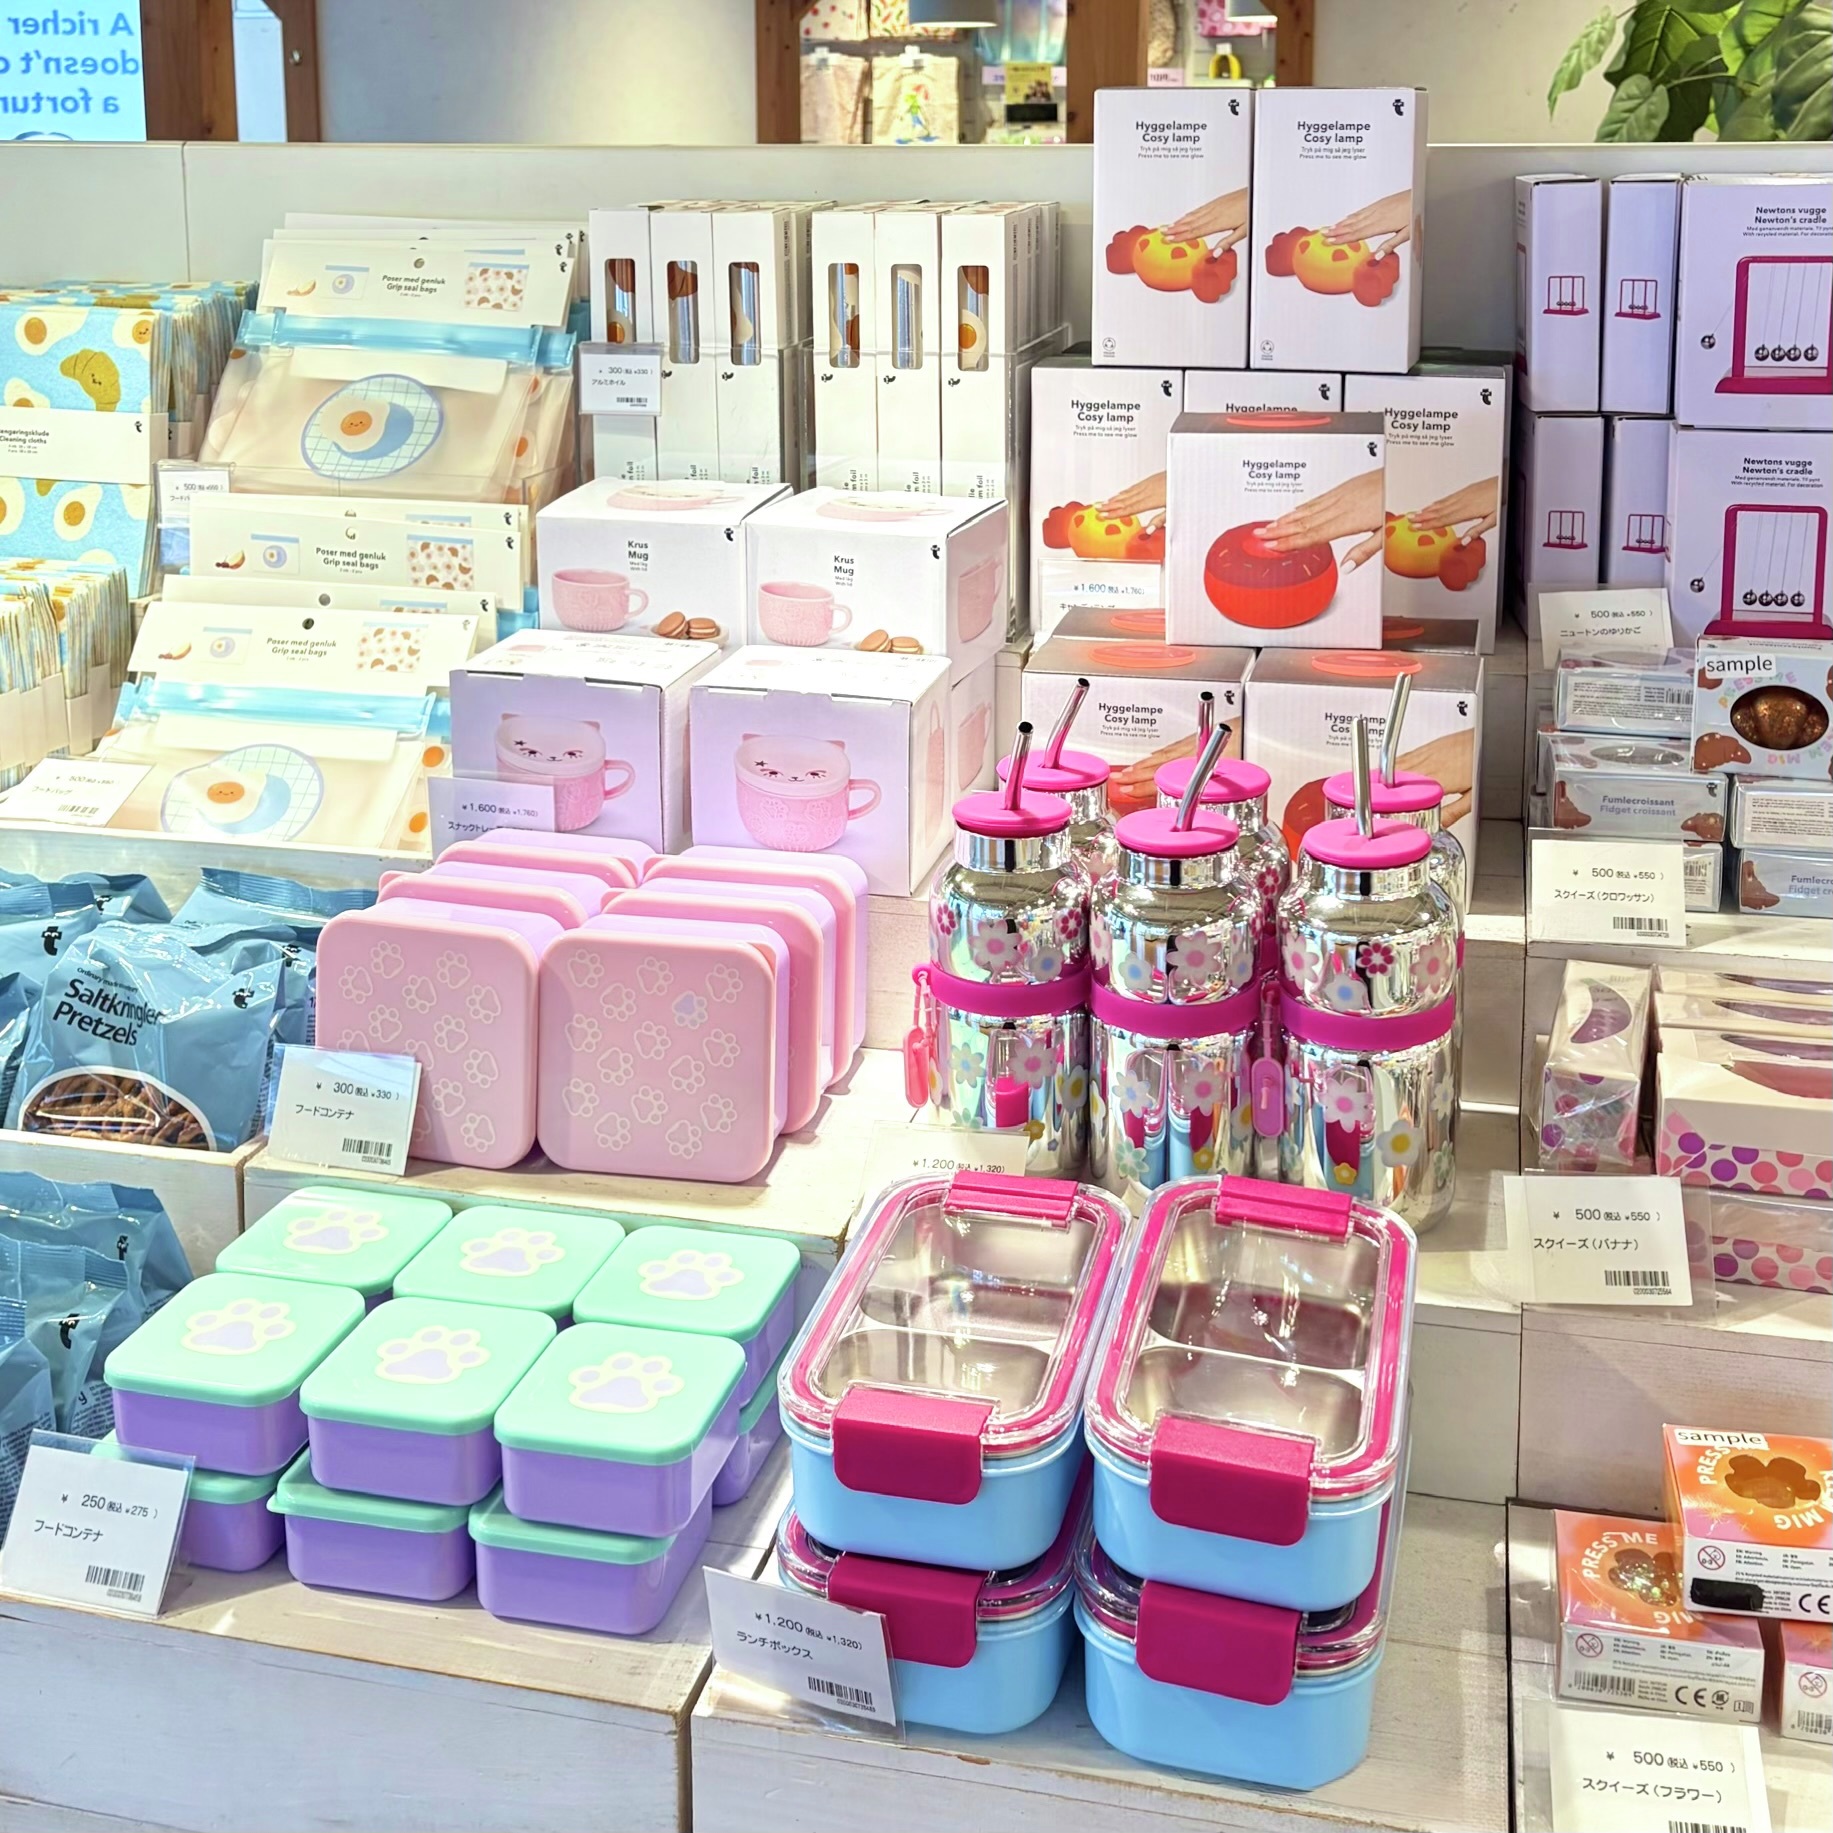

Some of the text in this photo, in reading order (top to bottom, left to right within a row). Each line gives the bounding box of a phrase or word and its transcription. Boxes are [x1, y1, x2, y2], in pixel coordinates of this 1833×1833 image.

[1135, 120, 1208, 133] Hyggelampe
[1297, 121, 1371, 134] Hyggelampe
[1142, 133, 1201, 145] Cosy lamp
[1304, 132, 1364, 146] Cosy lamp
[1798, 207, 1827, 215] vugge
[1755, 215, 1827, 224] Newton's cradle
[608, 366, 623, 374] 300
[592, 378, 626, 386] アルミホイル
[1071, 400, 1141, 413] Hyggelampe
[1077, 411, 1134, 425] Cosy lamp
[1384, 407, 1459, 421] Hyggelampe
[1391, 420, 1451, 433] Cosy lamp
[1242, 460, 1307, 470] Hyggelampe
[1743, 457, 1813, 468] Newtons vugge
[1248, 470, 1301, 481] Cosy lamp
[1742, 466, 1784, 474] Newton's
[628, 540, 648, 549] Krus
[316, 547, 386, 561] Poser med genluk
[628, 550, 649, 561] Mug
[834, 555, 854, 564] Krus
[323, 557, 340, 567] Grip
[359, 561, 379, 570] bags
[834, 565, 854, 576] Mug
[1590, 610, 1610, 618] 500
[1560, 626, 1641, 637] ニュートンのゆりかご
[272, 646, 289, 656] Grip
[308, 648, 327, 658] bags
[1706, 655, 1773, 675] sample
[1098, 702, 1163, 716] Hyggelampe
[1104, 714, 1157, 727] Cosy lamp
[1602, 795, 1675, 806] Fumlecroissant
[1600, 805, 1676, 816] Fidget croissant
[1592, 868, 1614, 878] 500
[64, 978, 165, 1028] Saltkringler
[52, 1001, 138, 1046] Pretzels
[333, 1082, 354, 1095] 300
[295, 1104, 355, 1120] フードコンテナ
[1575, 1209, 1601, 1220] 500
[1678, 1431, 1762, 1445] sample
[81, 1494, 106, 1510] 250
[34, 1519, 104, 1542] フードコンテナ
[1581, 1532, 1659, 1579] PRESS ME
[736, 1631, 813, 1660] ランチボックス
[1633, 1751, 1664, 1766] 500
